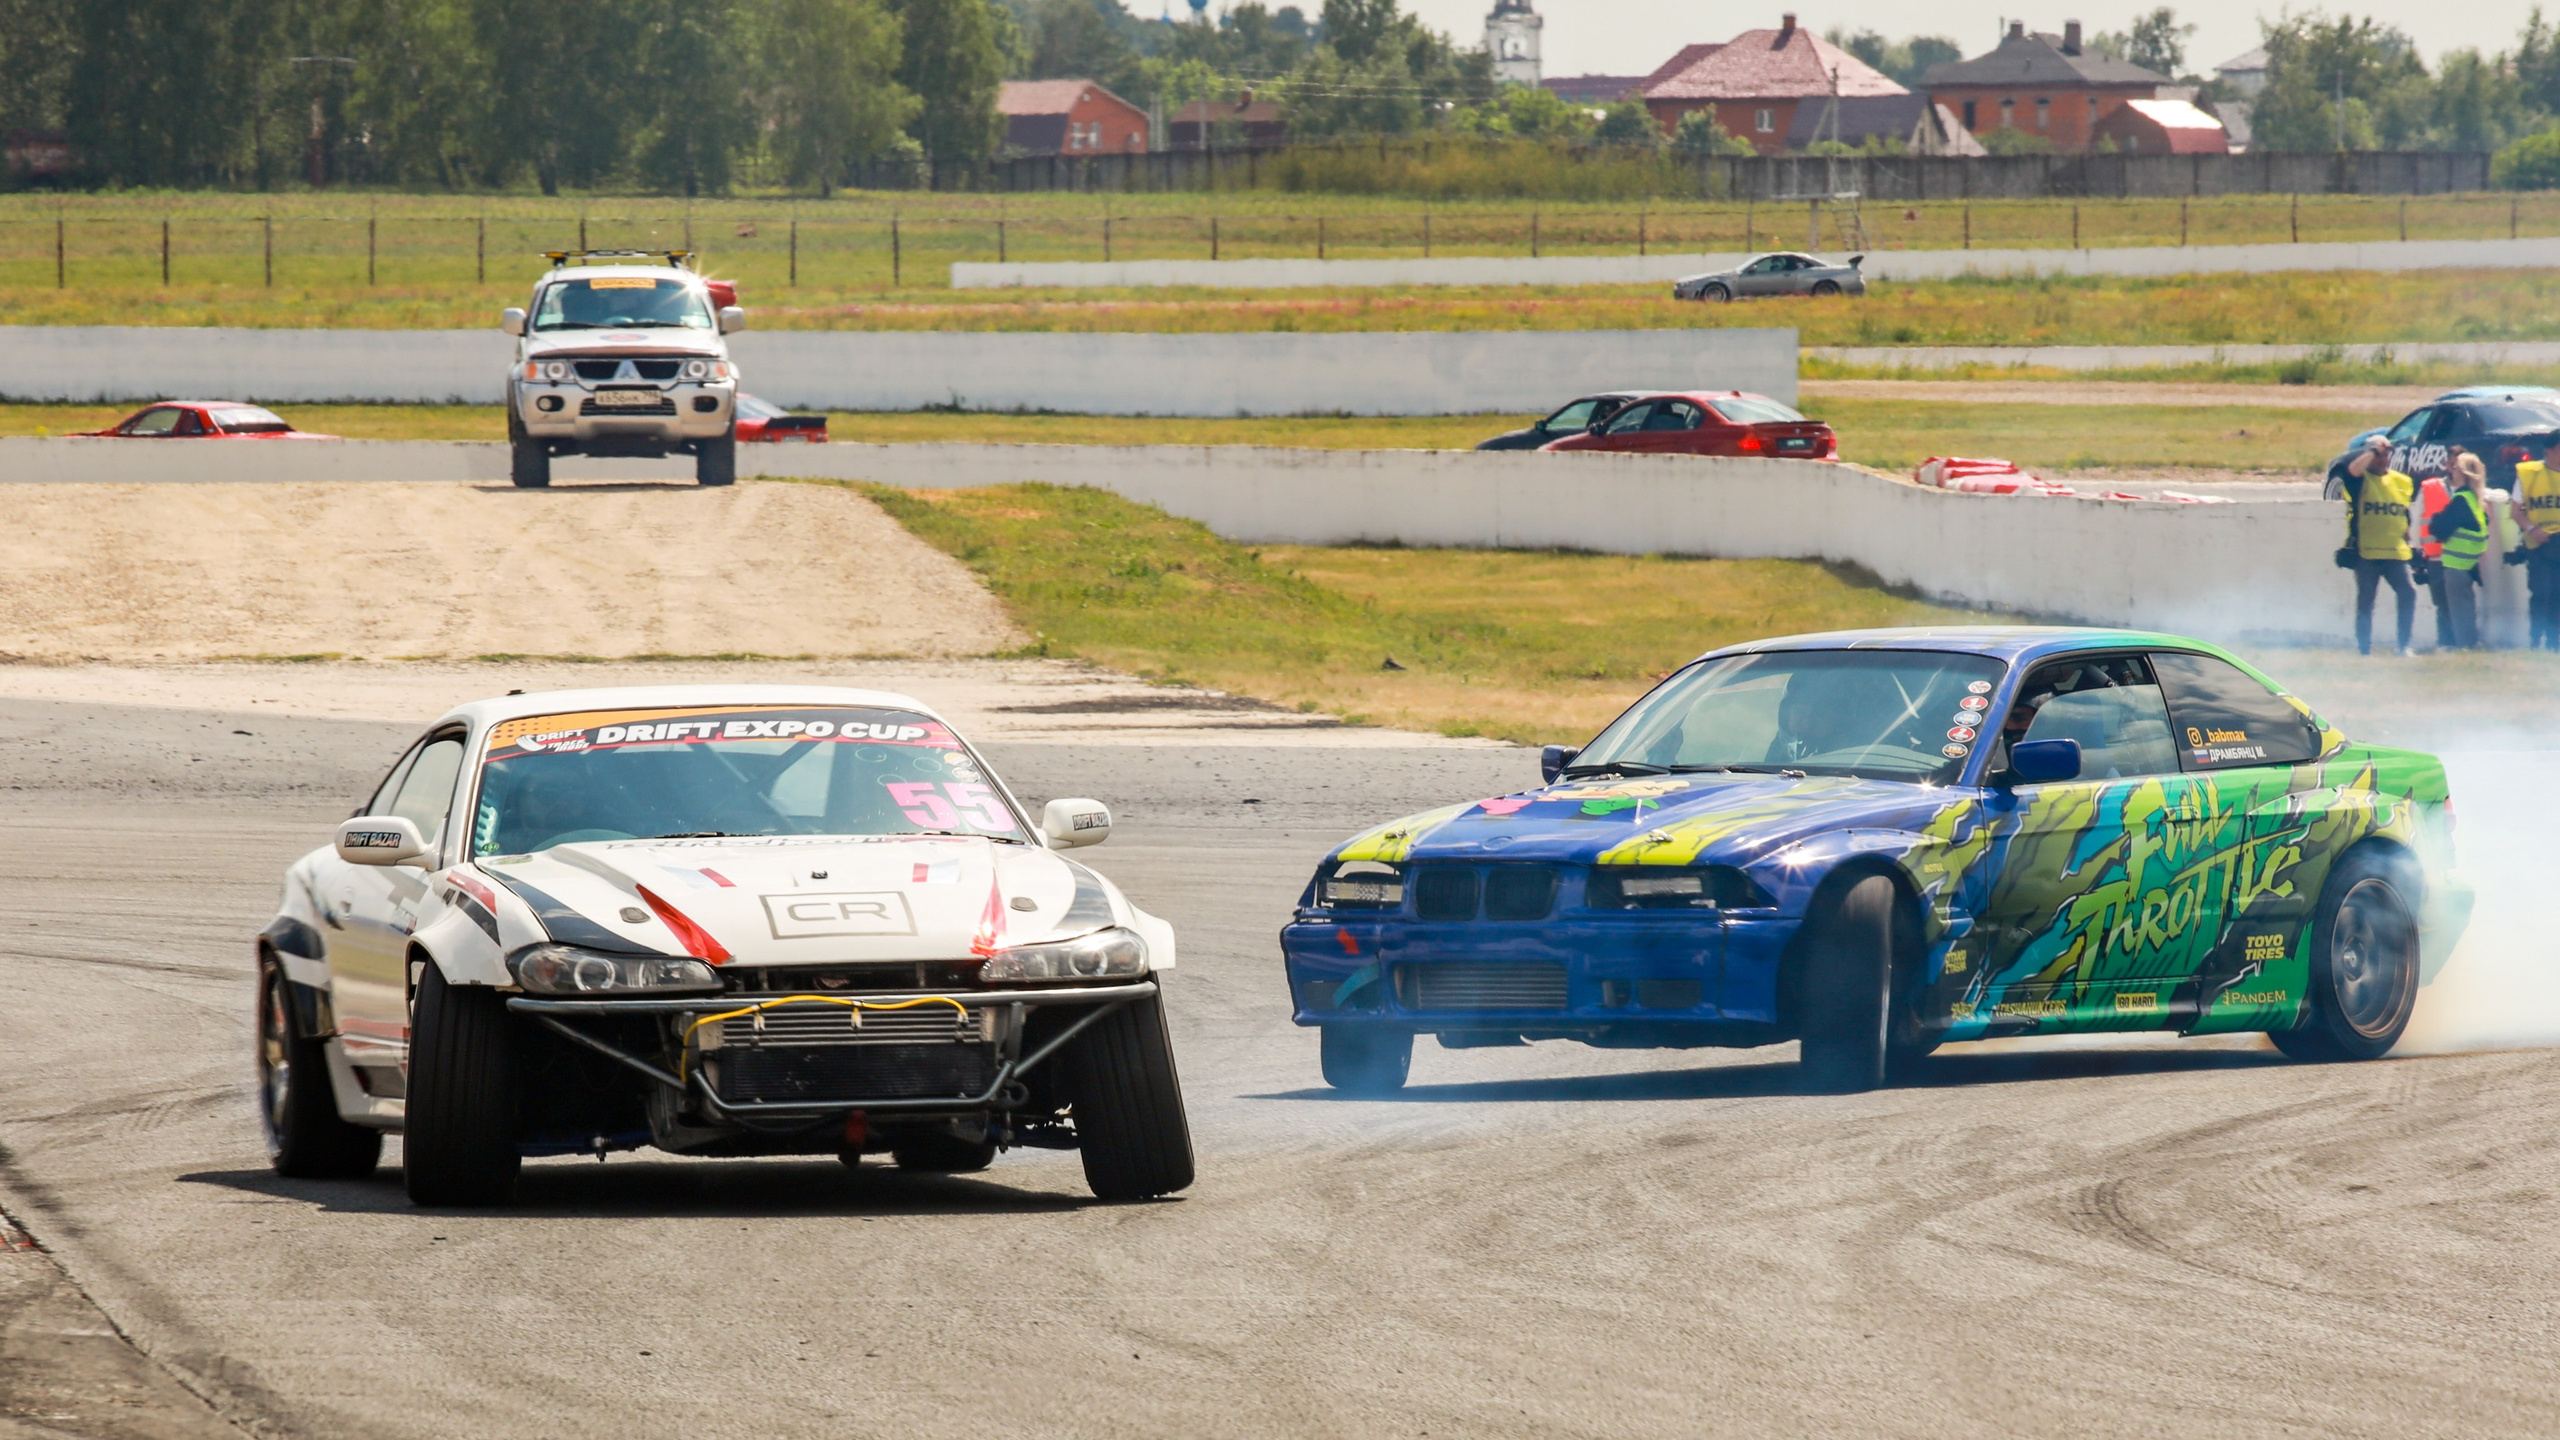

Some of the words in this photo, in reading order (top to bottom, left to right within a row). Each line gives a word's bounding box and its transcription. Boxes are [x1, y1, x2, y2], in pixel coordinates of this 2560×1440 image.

[2529, 495, 2560, 509] ME
[536, 729, 585, 742] DRIFT
[596, 721, 720, 744] DRIFT
[723, 720, 835, 738] EXPO
[840, 721, 926, 741] CUP
[2209, 747, 2257, 762] ДРАМБЯНЦ
[886, 782, 1015, 832] 55
[346, 832, 370, 846] DRIFT
[369, 832, 400, 847] BAZAR
[786, 901, 893, 921] CR
[2246, 934, 2284, 948] TOYO
[2245, 947, 2285, 961] TIRES
